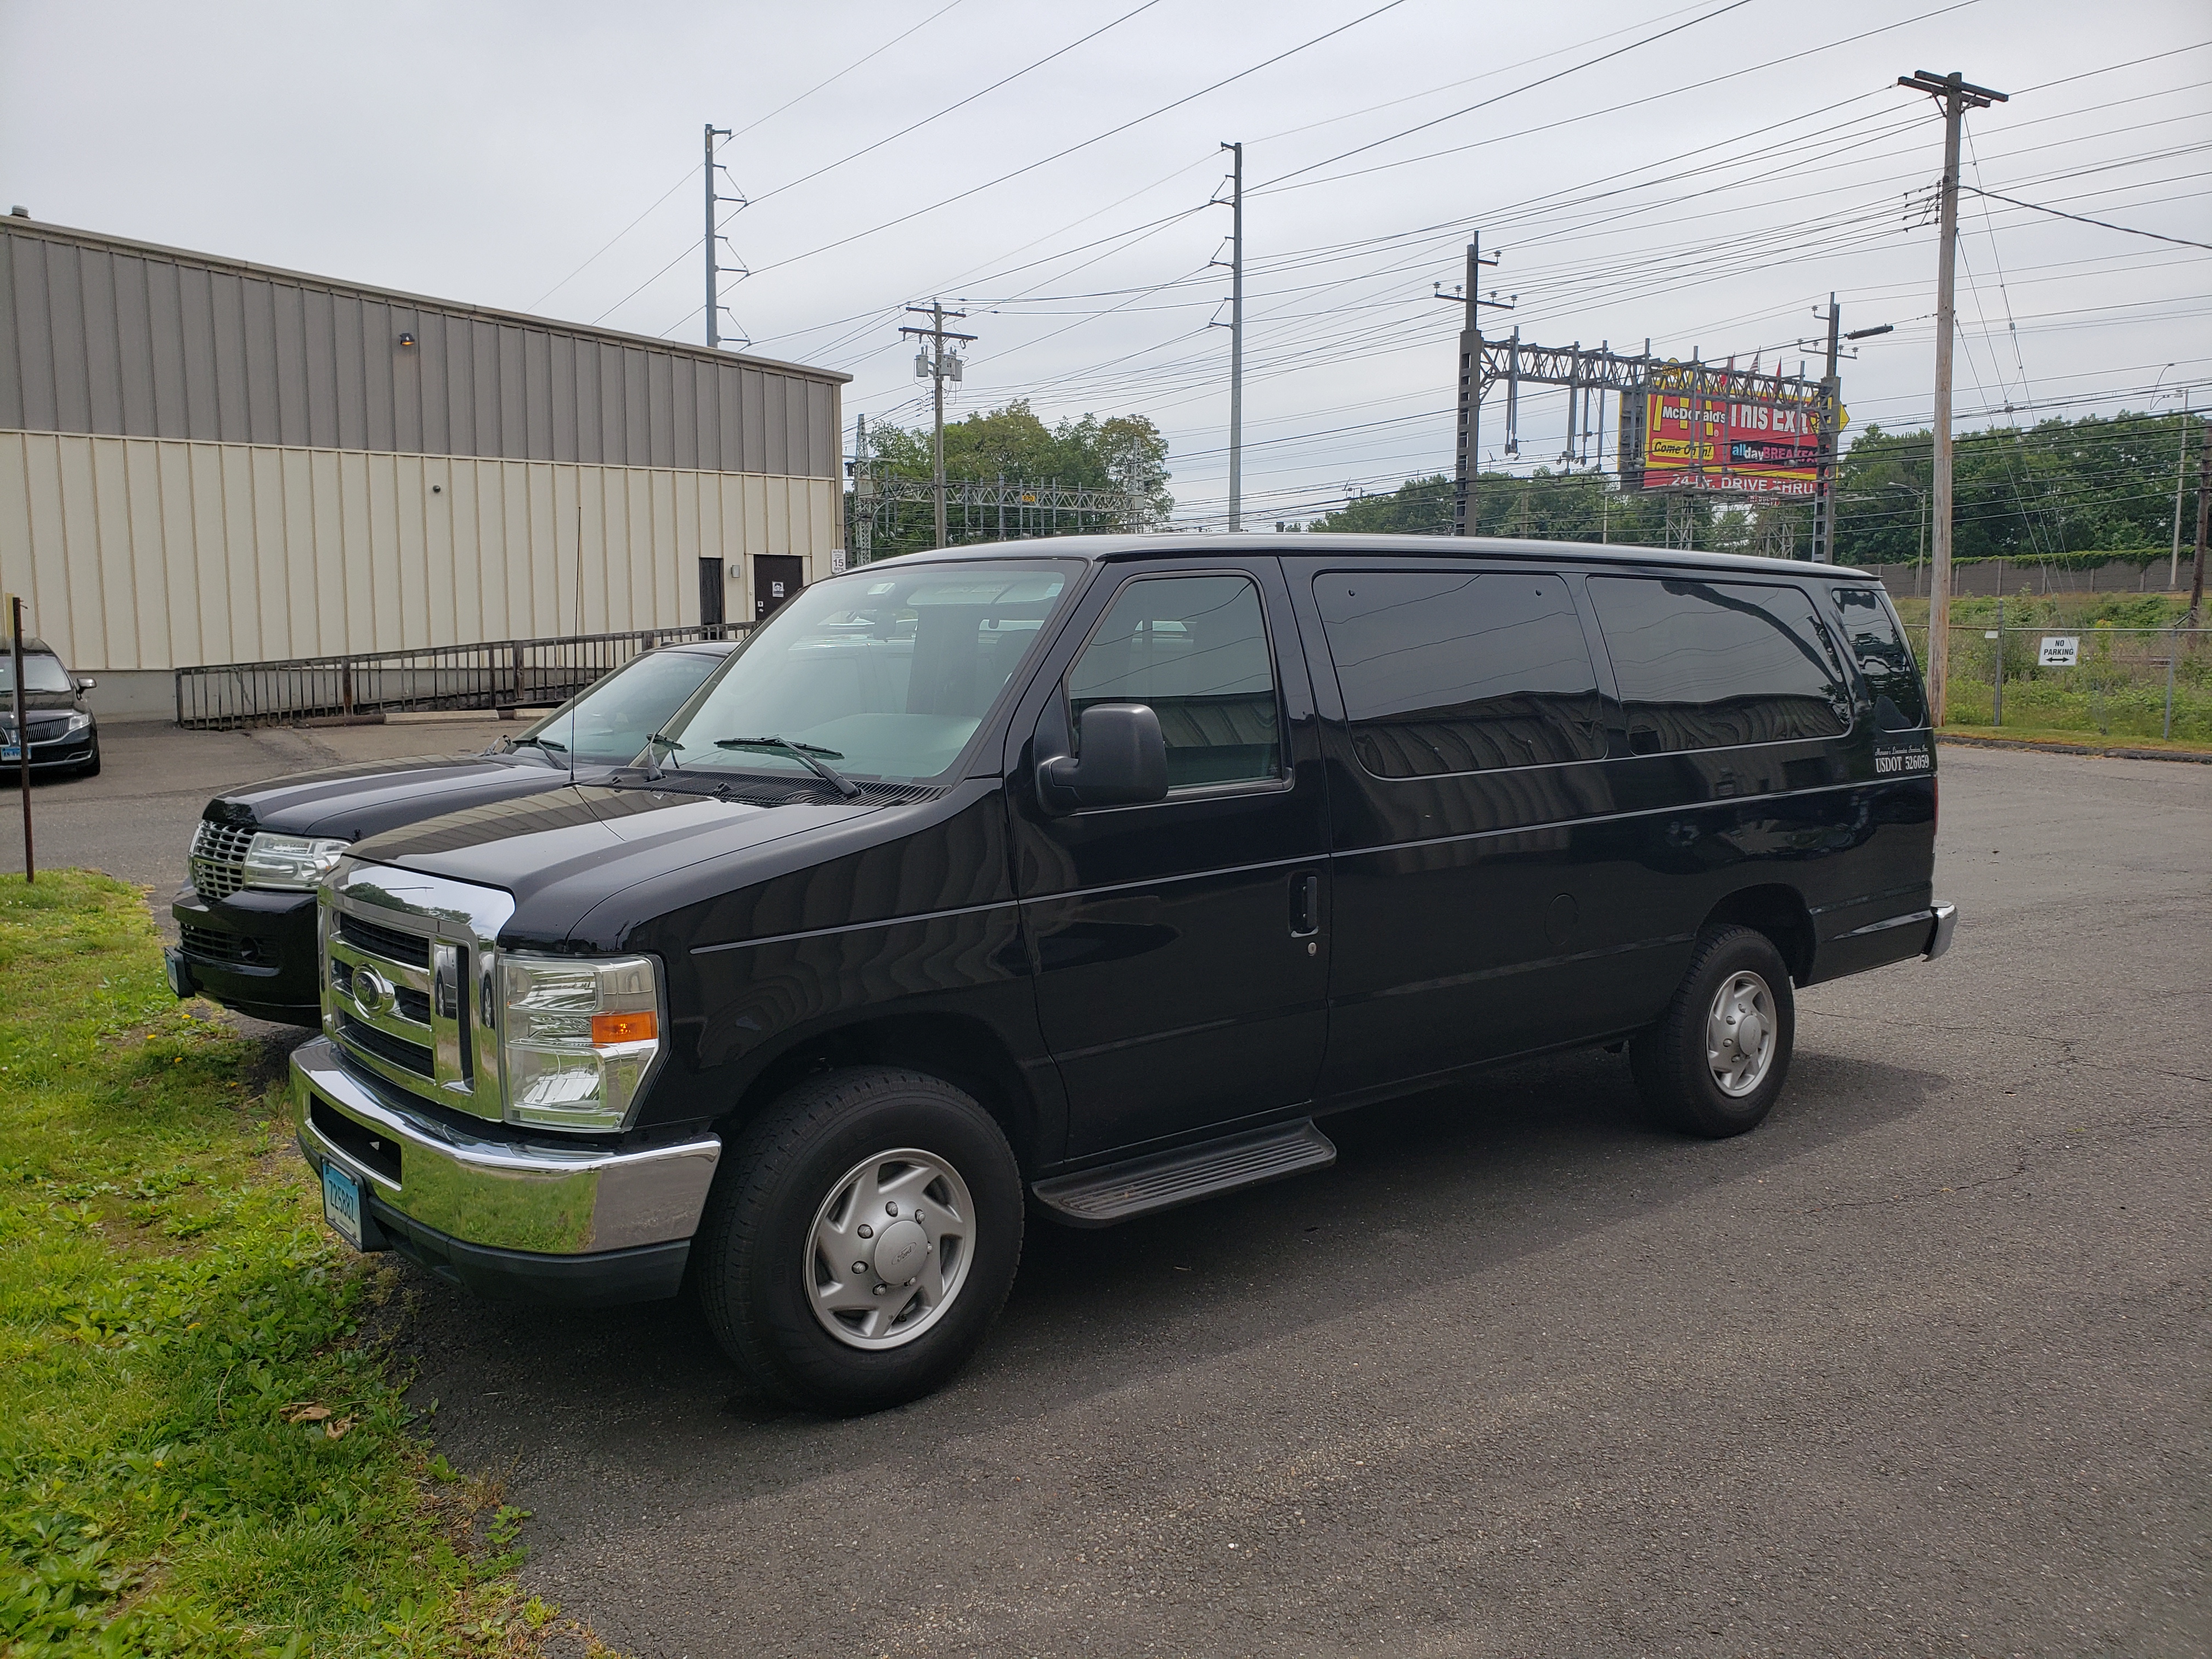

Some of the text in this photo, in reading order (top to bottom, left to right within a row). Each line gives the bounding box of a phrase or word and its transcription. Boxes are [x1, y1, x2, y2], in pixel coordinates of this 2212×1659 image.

[1773, 400, 1808, 434] Ext
[1654, 442, 1680, 454] Come
[1721, 478, 1768, 491] DRIVE
[1772, 480, 1814, 494] THRU
[833, 558, 844, 567] 15
[1875, 754, 1929, 772] USDOT 526059
[897, 1245, 912, 1262] Ford
